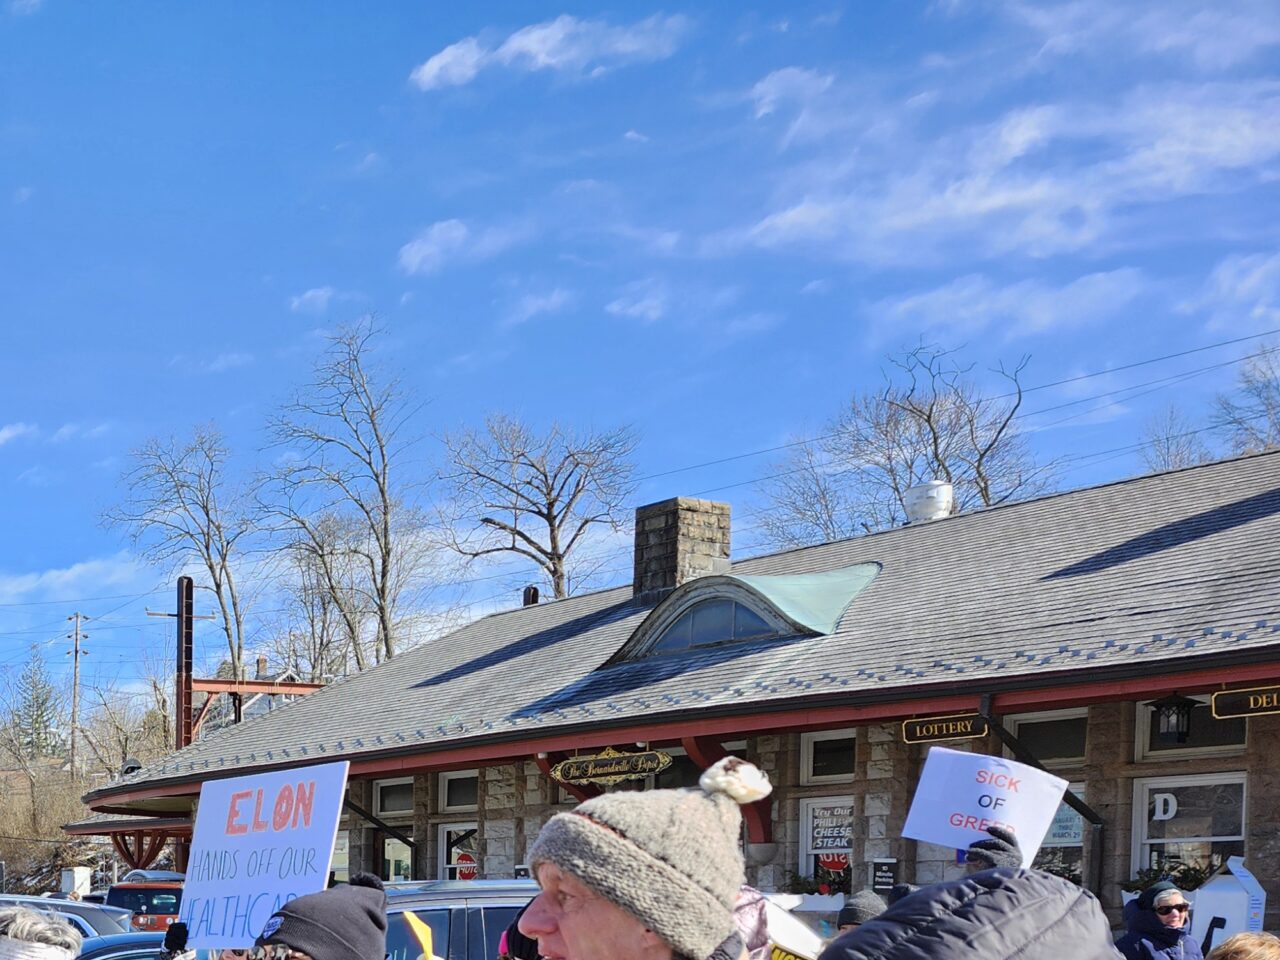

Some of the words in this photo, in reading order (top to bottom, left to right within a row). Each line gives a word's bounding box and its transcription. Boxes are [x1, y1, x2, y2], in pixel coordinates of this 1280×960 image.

[916, 720, 973, 737] LOTTERY
[975, 769, 1022, 792] SICK
[225, 781, 317, 836] ELON
[978, 794, 1006, 810] OF
[1153, 793, 1178, 820] D
[814, 808, 831, 817] Try
[834, 807, 852, 815] Our
[814, 827, 852, 837] CHEESE
[816, 838, 848, 847] STEAK
[191, 849, 238, 882] HANDS
[247, 848, 279, 878] OFF
[278, 847, 318, 880] OUR
